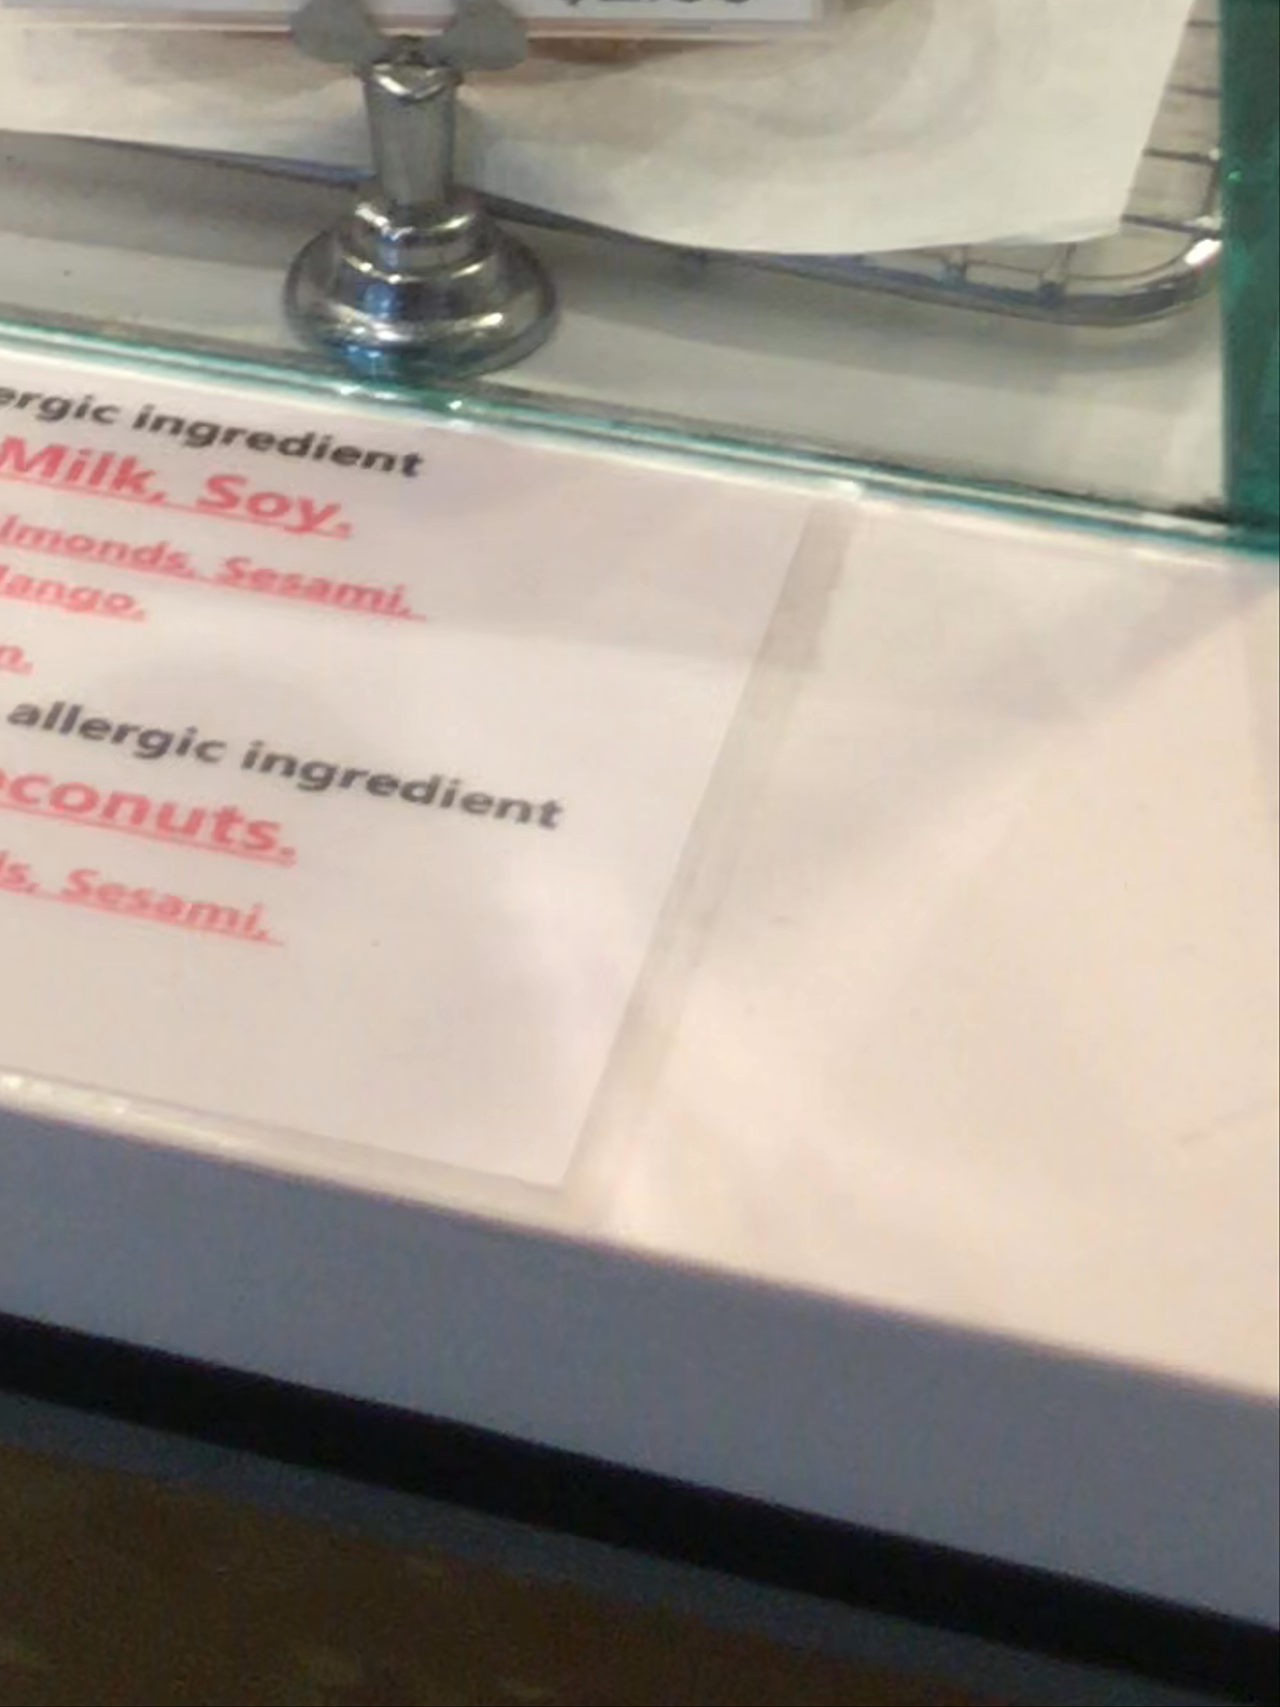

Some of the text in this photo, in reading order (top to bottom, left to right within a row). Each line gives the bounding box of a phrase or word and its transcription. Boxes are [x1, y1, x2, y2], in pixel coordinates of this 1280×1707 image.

[132, 403, 426, 479] ingredient
[7, 700, 228, 763] allergic
[239, 740, 565, 830] ingredient
